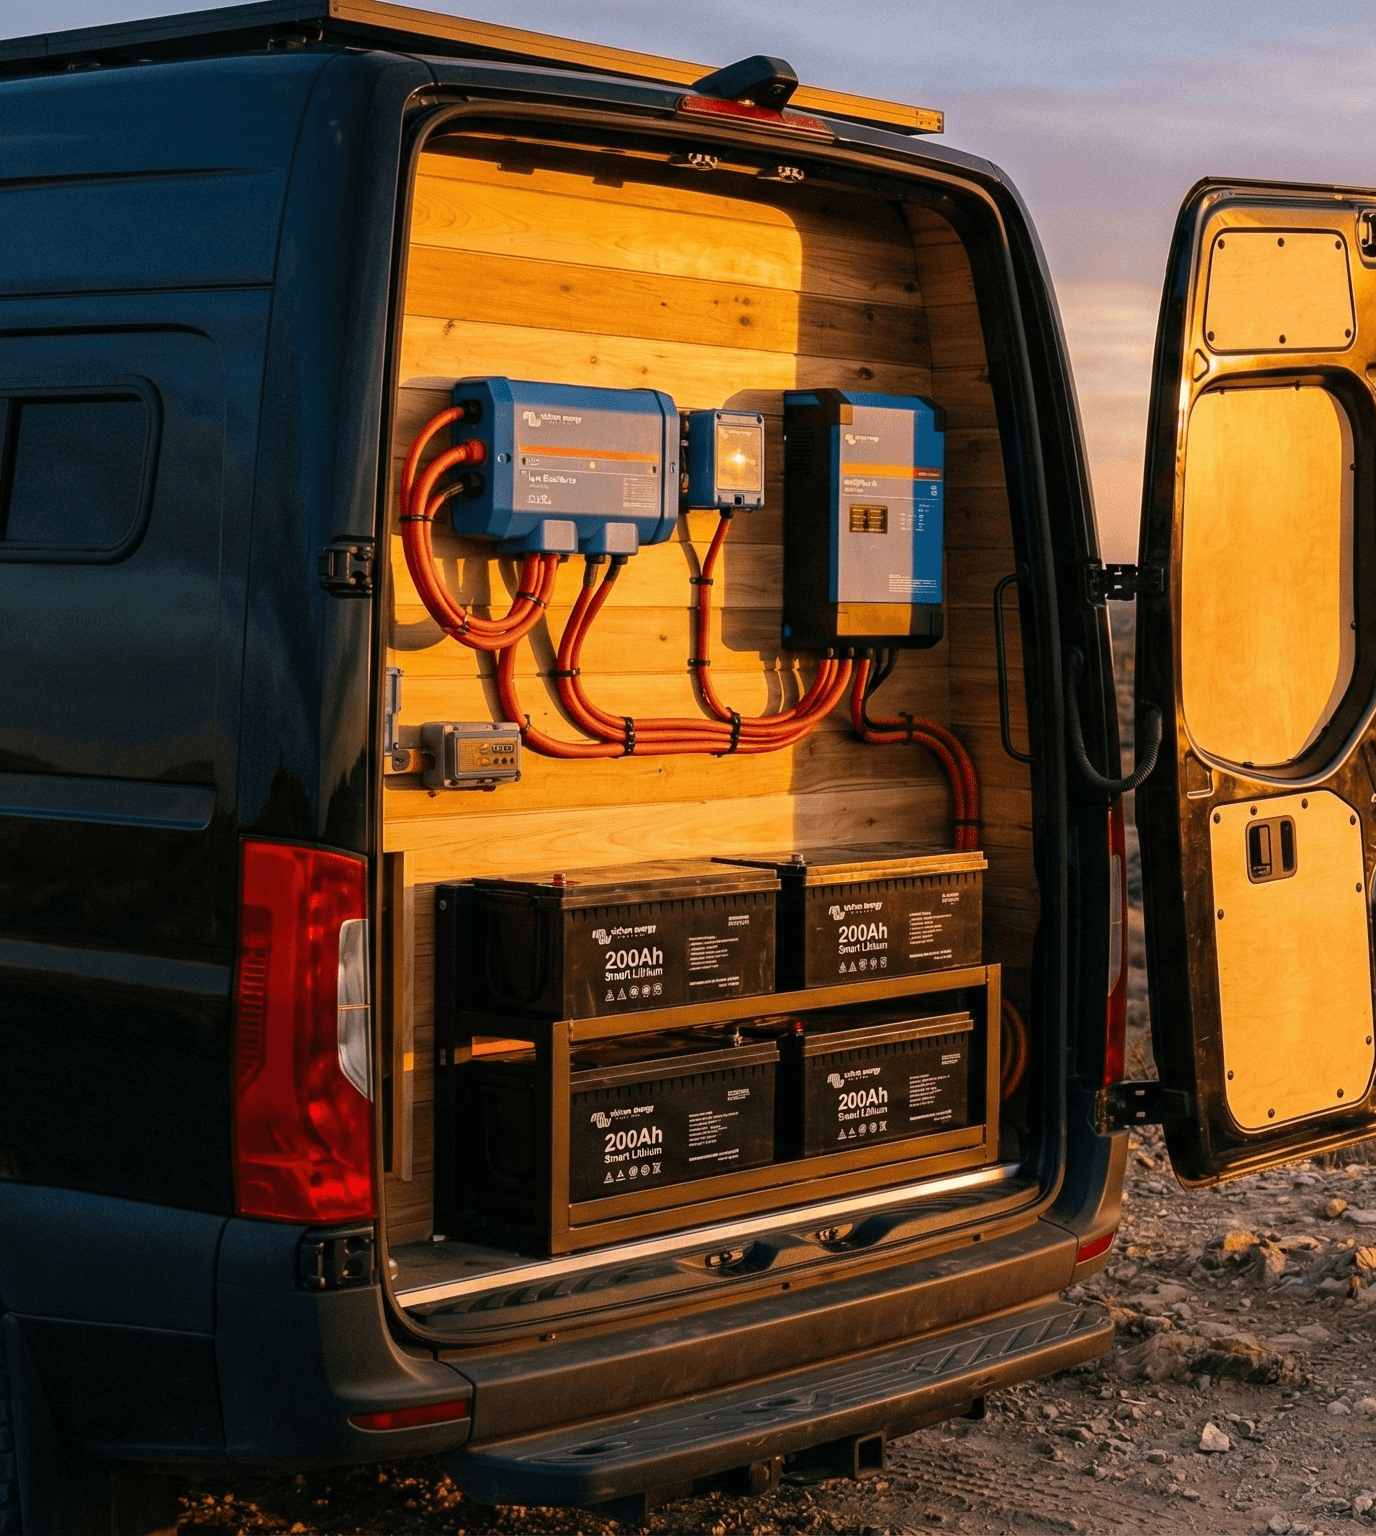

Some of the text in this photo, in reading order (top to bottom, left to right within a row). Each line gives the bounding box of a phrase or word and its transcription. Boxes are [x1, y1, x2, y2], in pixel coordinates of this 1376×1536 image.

[838, 922, 888, 944] 200Ah
[605, 947, 664, 970] 200Ah
[838, 943, 861, 955] Smart
[838, 1087, 888, 1111] 200Ah
[604, 1126, 663, 1153] 200Ah
[604, 1151, 631, 1164] Smart
